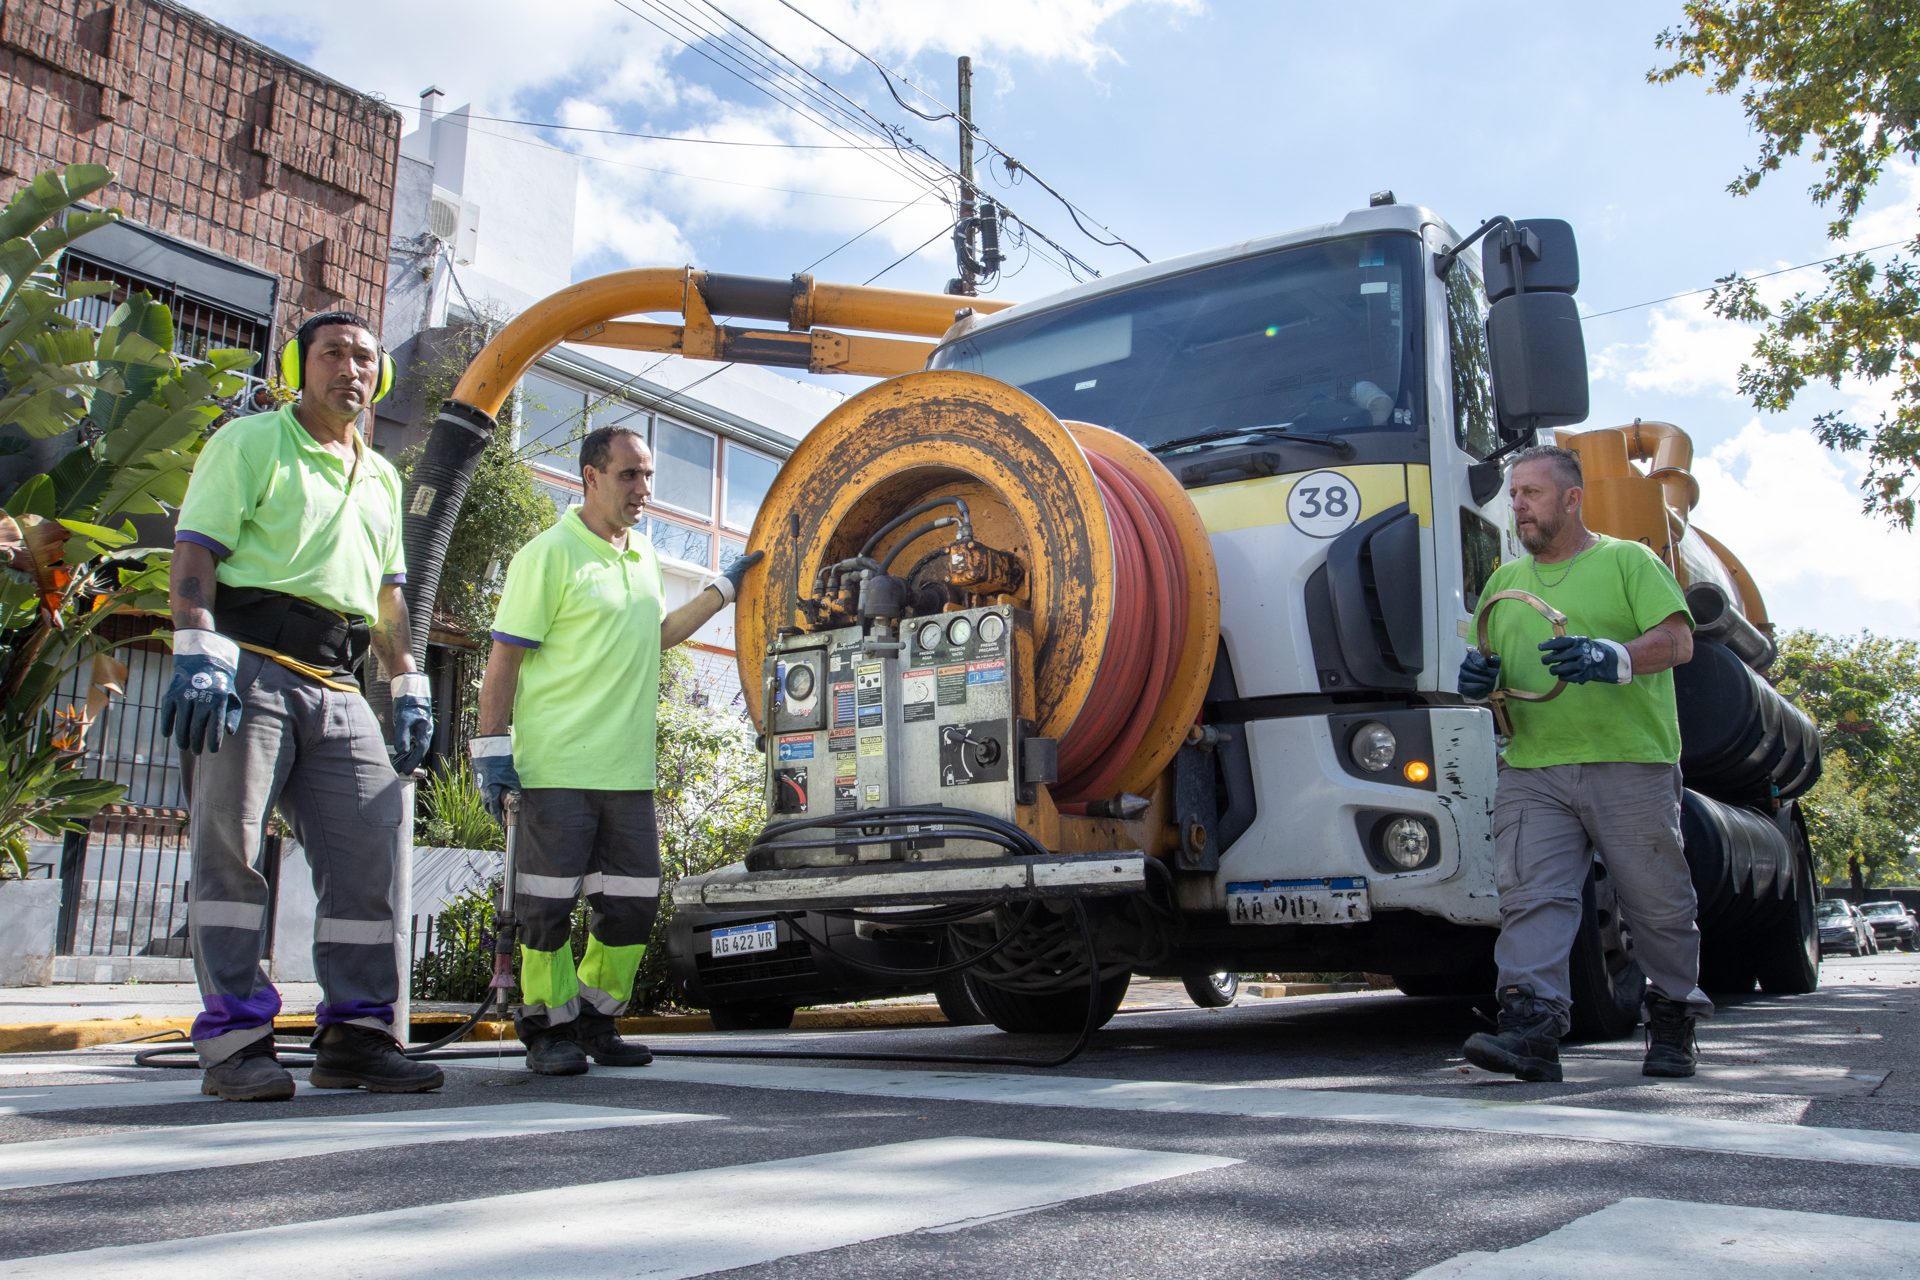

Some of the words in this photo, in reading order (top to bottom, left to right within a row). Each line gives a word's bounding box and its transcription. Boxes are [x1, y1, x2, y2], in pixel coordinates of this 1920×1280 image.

[1299, 486, 1348, 518] 38
[835, 728, 855, 736] PELIGR
[1236, 895, 1265, 920] AA
[715, 938, 729, 954] AG
[733, 935, 754, 951] 422
[758, 931, 773, 948] VR
